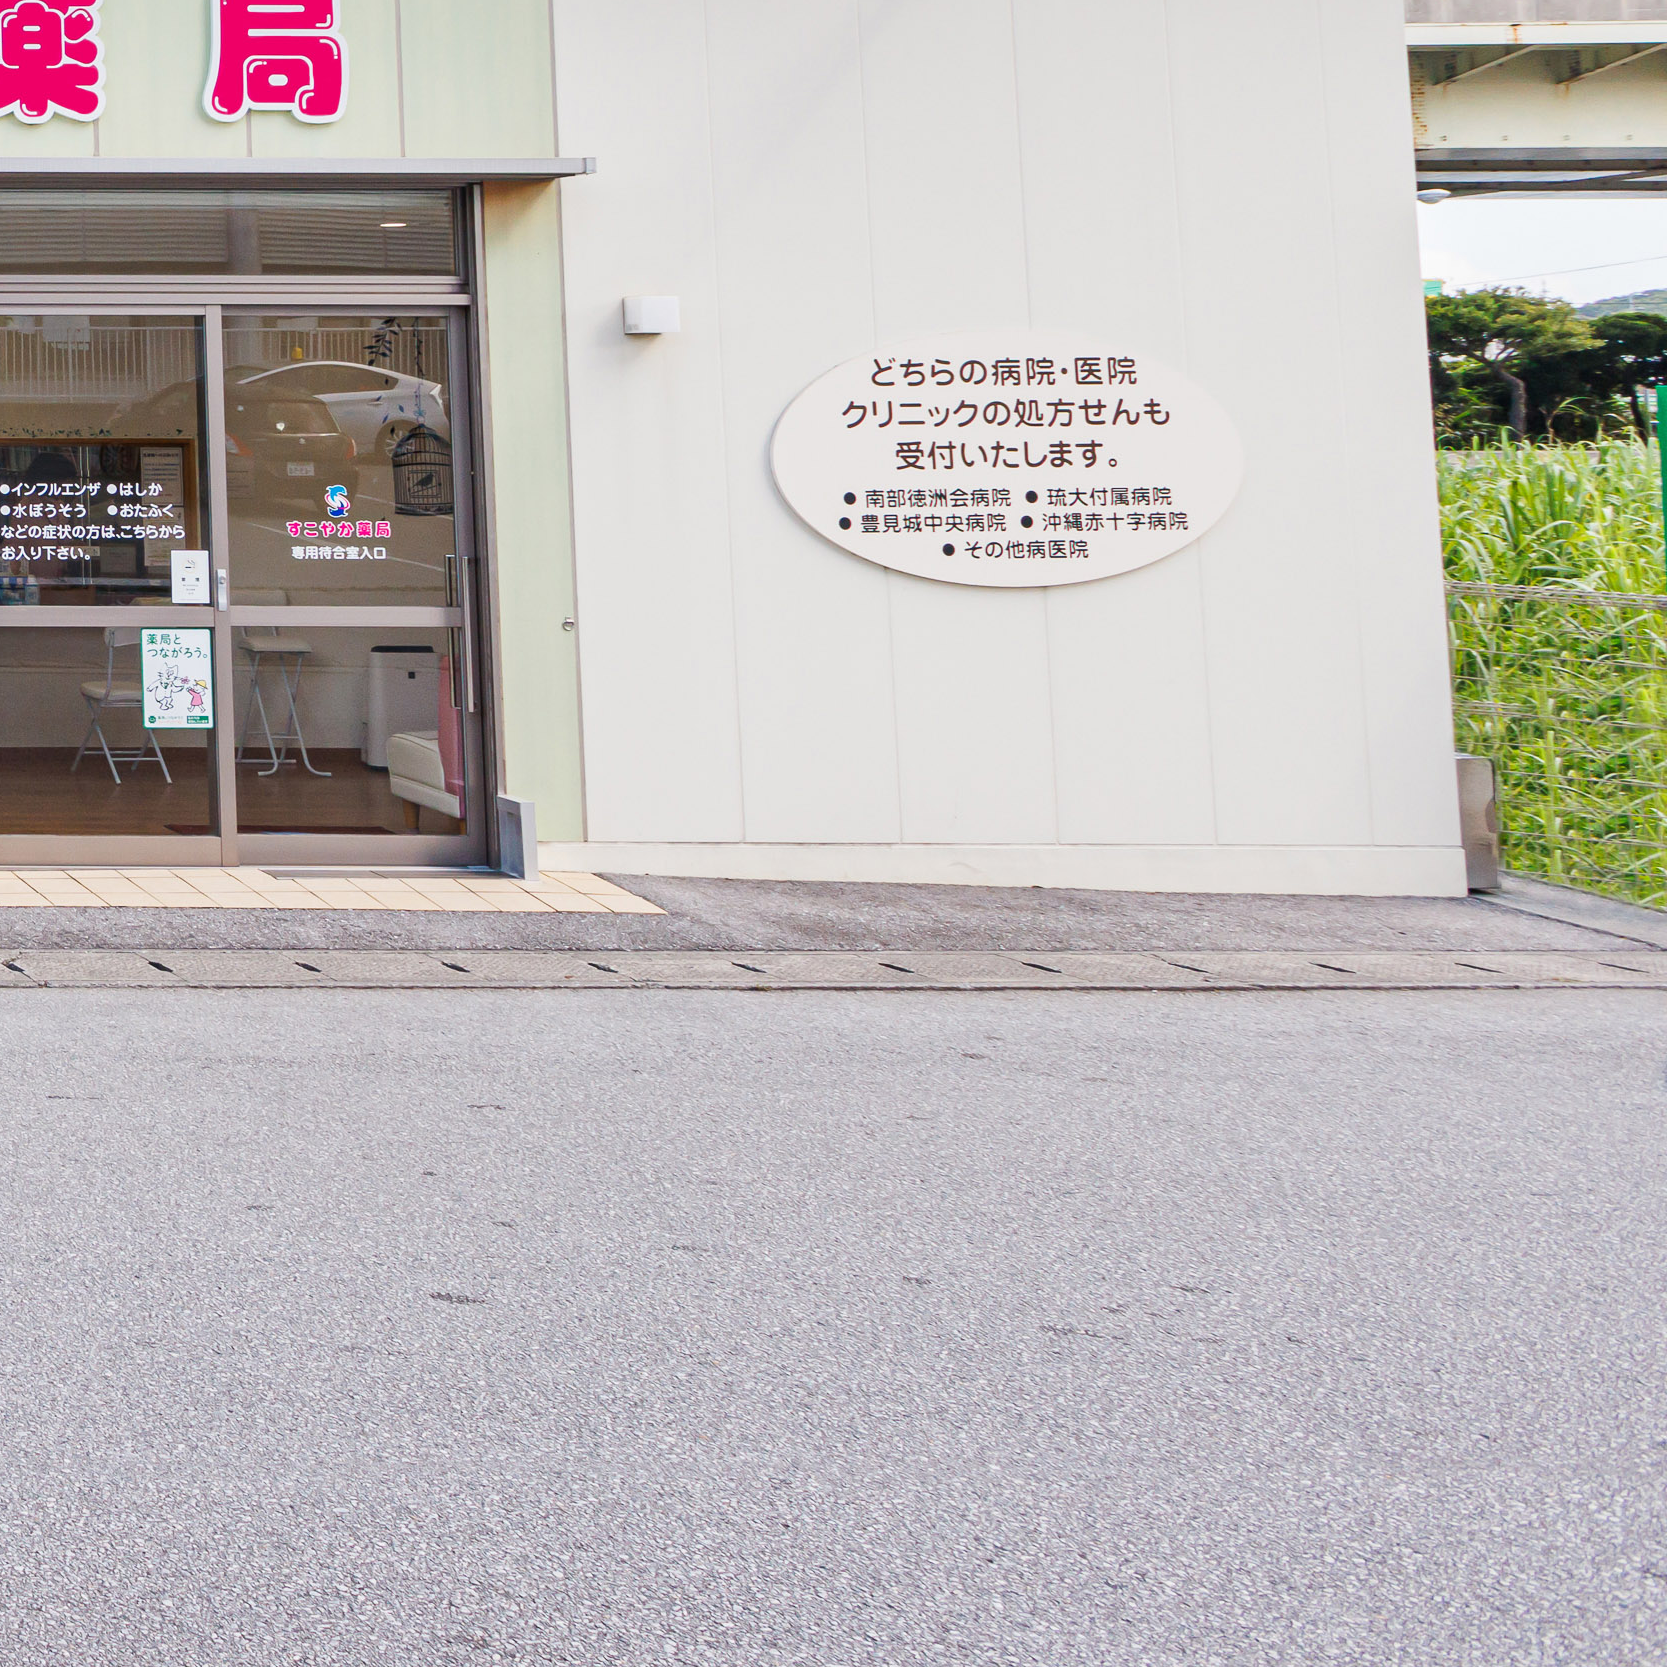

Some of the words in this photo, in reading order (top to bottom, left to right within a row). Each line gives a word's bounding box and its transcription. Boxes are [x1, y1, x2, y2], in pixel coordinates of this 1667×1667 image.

[870, 356, 1138, 387] どちらの病院・医院
[841, 398, 1171, 429] クリニックの処方せんも
[895, 439, 1119, 470] 受付いたします。
[11, 482, 101, 496] インフルエンザ
[119, 482, 163, 497] はしか
[864, 488, 1012, 508] 南部徳洲会病院
[1046, 487, 1173, 507] 琉大付属病院
[12, 503, 87, 518] 水ぼうそう
[119, 503, 174, 518] おたふく
[286, 521, 391, 538] すこやか薬局
[860, 513, 1007, 533] 豊見城中央病院
[1041, 511, 1189, 532] 沖縄赤十字病院
[0, 525, 186, 539] などの症状の方は、こちらから
[1, 545, 91, 561] お入り下さい。
[291, 545, 387, 560] 専用待合室入口
[963, 540, 1090, 559] その他病医院
[147, 633, 181, 645] 薬局と
[147, 646, 208, 659] つながろう。
